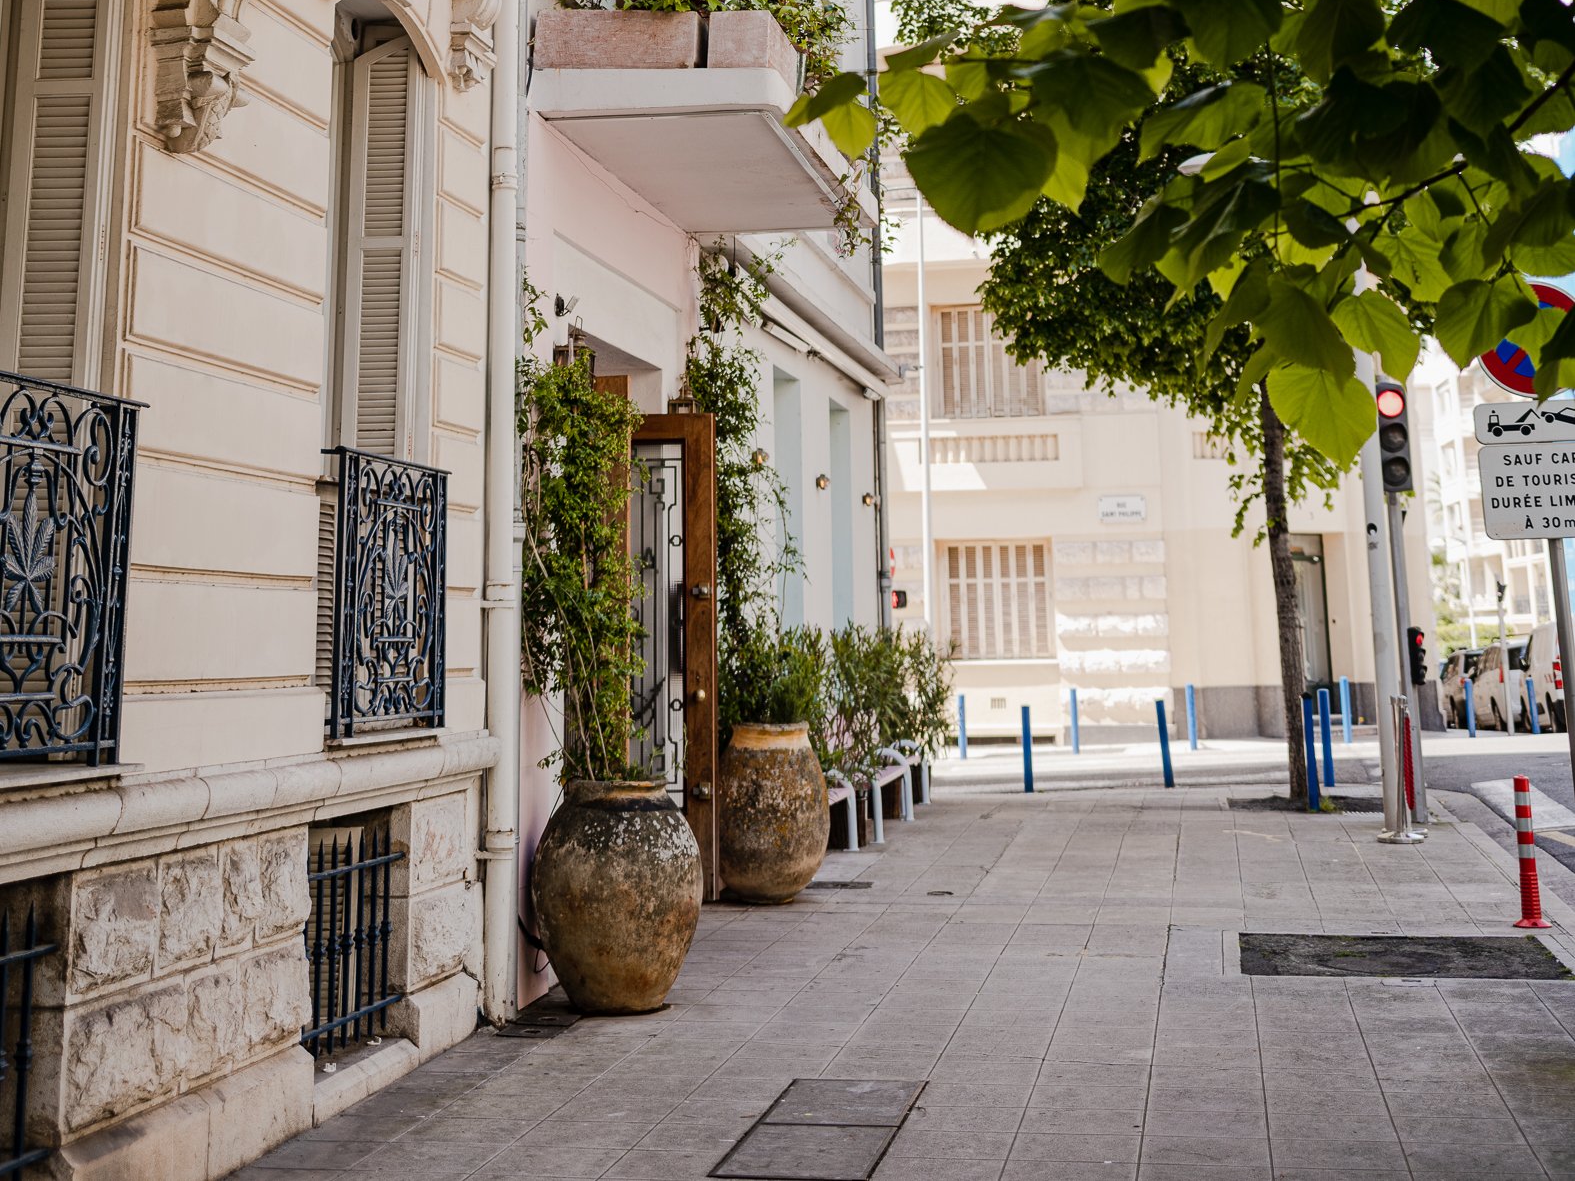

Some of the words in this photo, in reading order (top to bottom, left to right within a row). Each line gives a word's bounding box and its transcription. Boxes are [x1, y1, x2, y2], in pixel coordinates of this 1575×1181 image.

[1503, 453, 1543, 466] SAUF
[1495, 475, 1515, 488] DE
[1490, 493, 1543, 509] DURÉE
[1550, 494, 1575, 507] LIM
[1524, 515, 1534, 529] À
